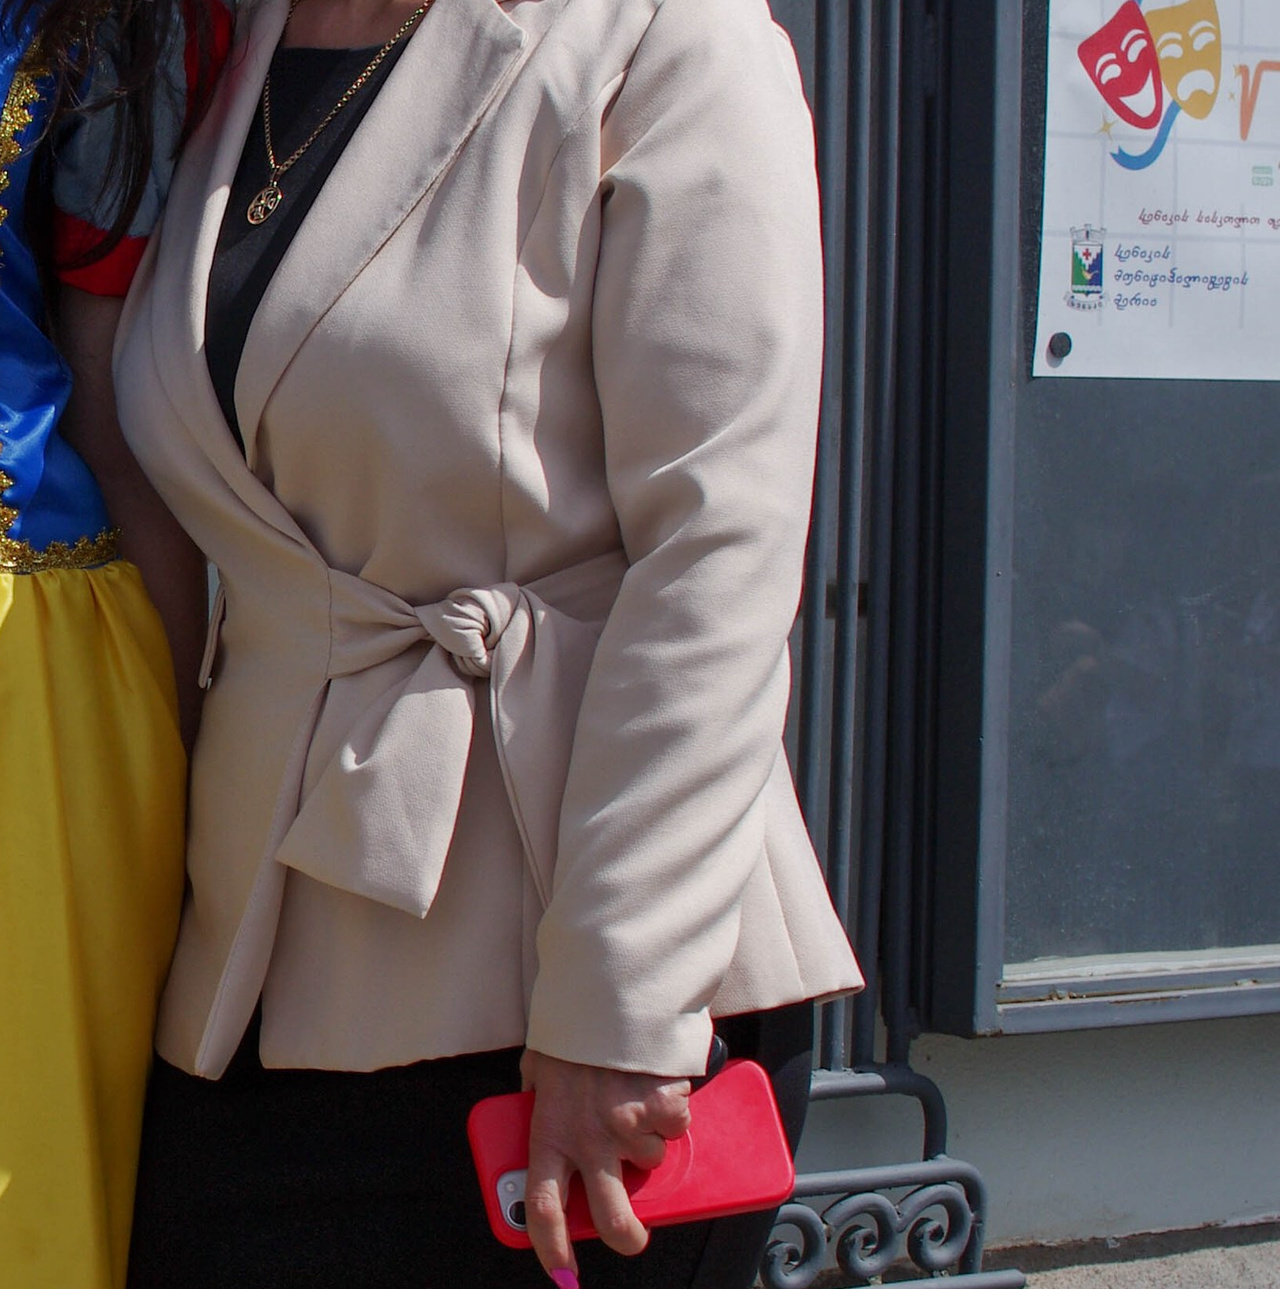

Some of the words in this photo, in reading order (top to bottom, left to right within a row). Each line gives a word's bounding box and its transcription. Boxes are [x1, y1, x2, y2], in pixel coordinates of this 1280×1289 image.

[1138, 207, 1189, 226] სენაკის
[1114, 244, 1171, 263] სენაკის
[1114, 266, 1250, 292] მუნიციპალიტეტის
[1113, 292, 1158, 311] მერია
